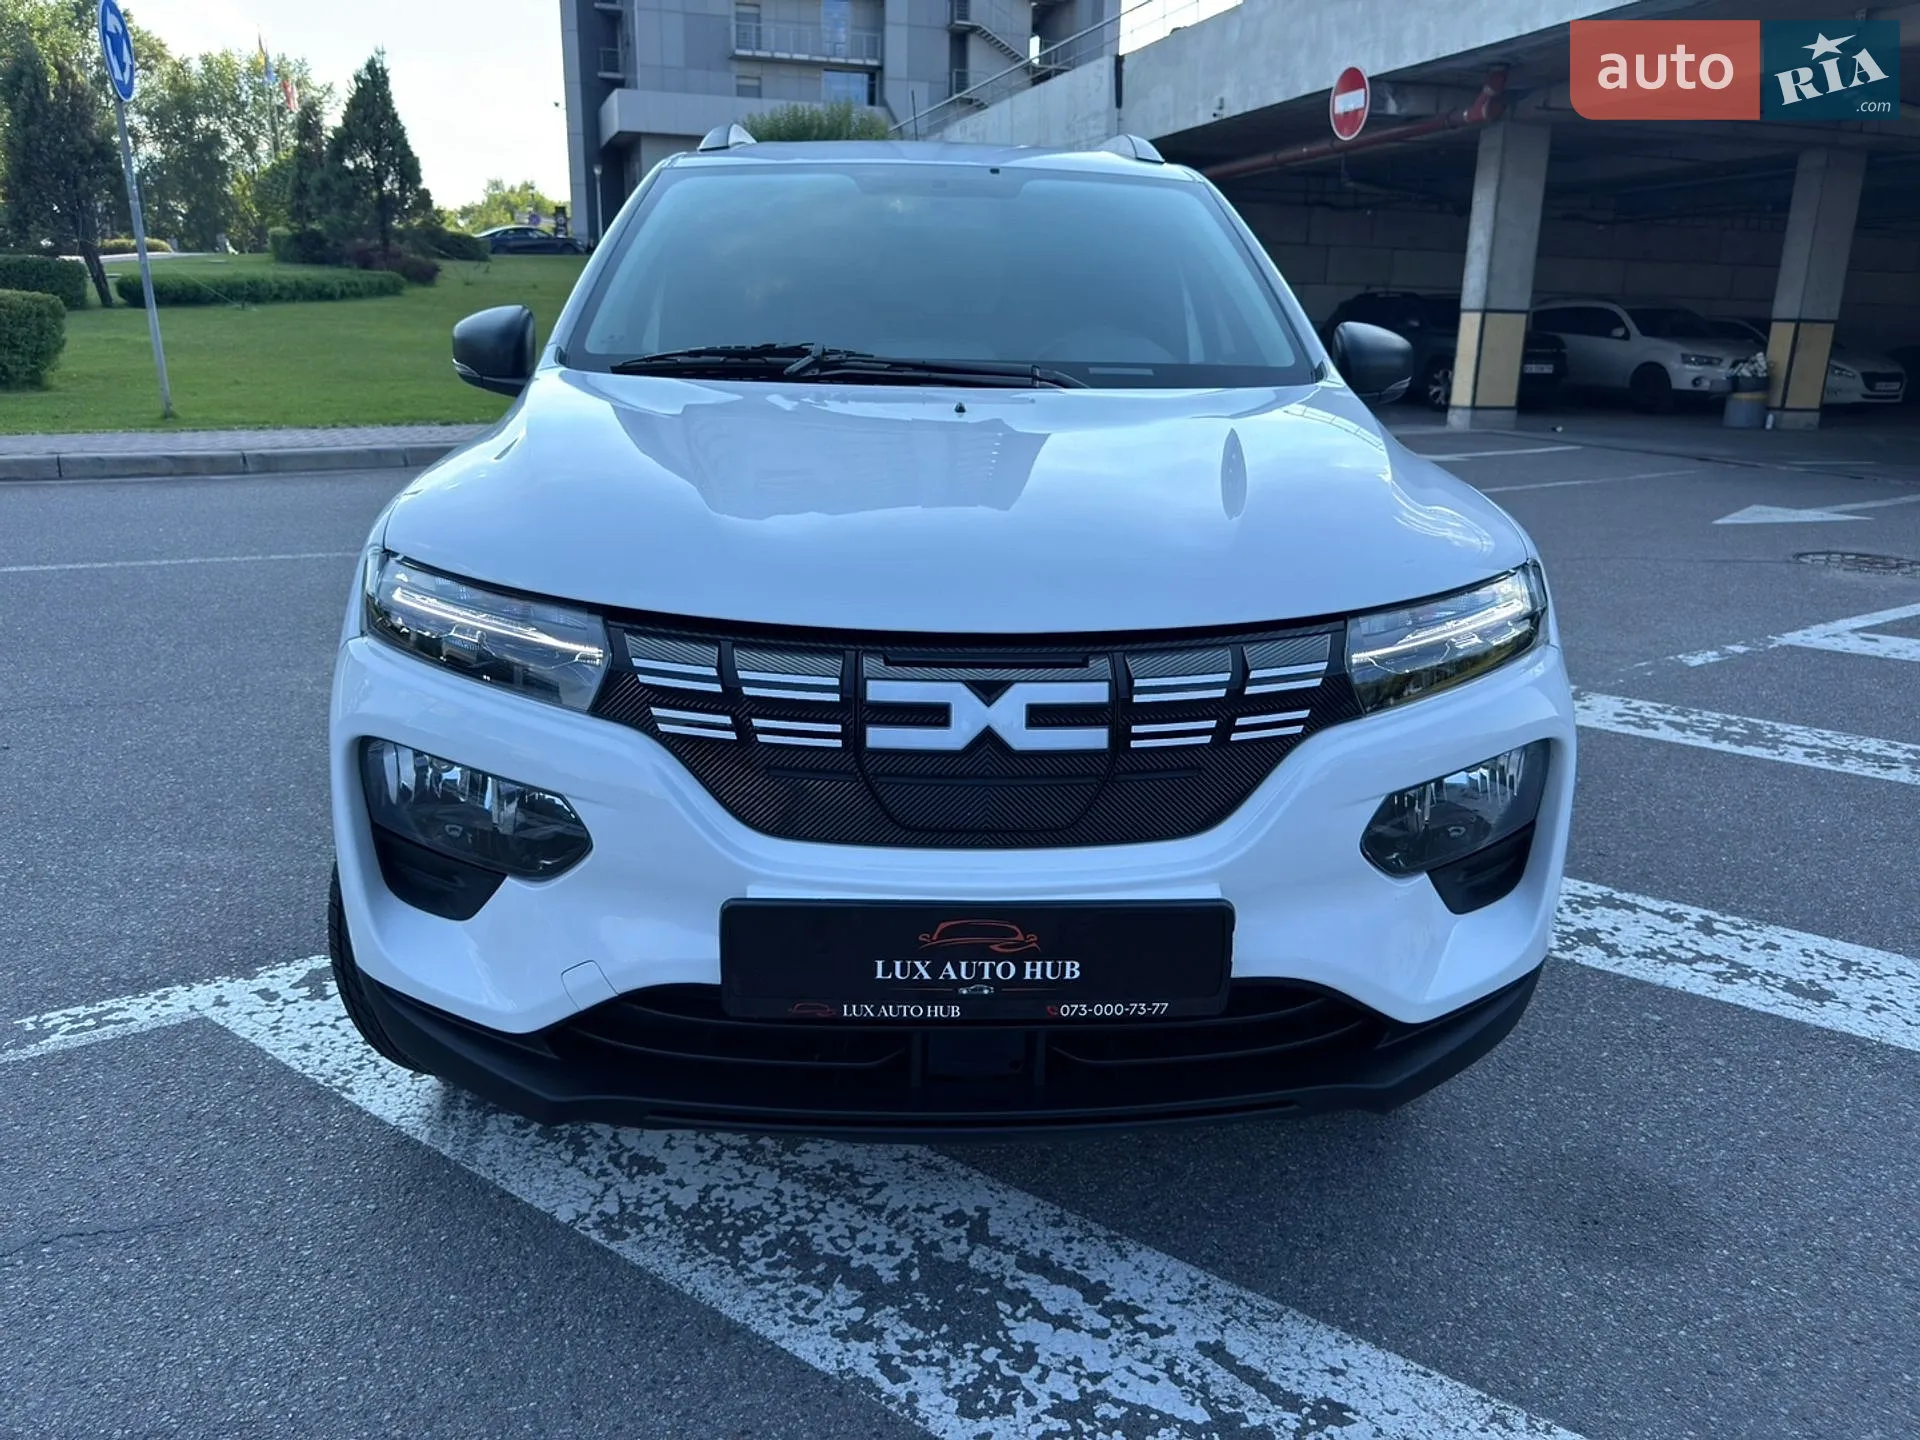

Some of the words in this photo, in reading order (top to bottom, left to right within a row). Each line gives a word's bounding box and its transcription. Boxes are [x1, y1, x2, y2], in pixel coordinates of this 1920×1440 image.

[874, 960, 932, 980] LUX
[938, 960, 1016, 980] AUTO
[1023, 960, 1080, 980] HUB
[842, 1004, 875, 1018] LUX
[877, 1004, 923, 1018] AUTO
[926, 1004, 961, 1018] HUB
[1060, 1002, 1169, 1017] 073-000-73-77
